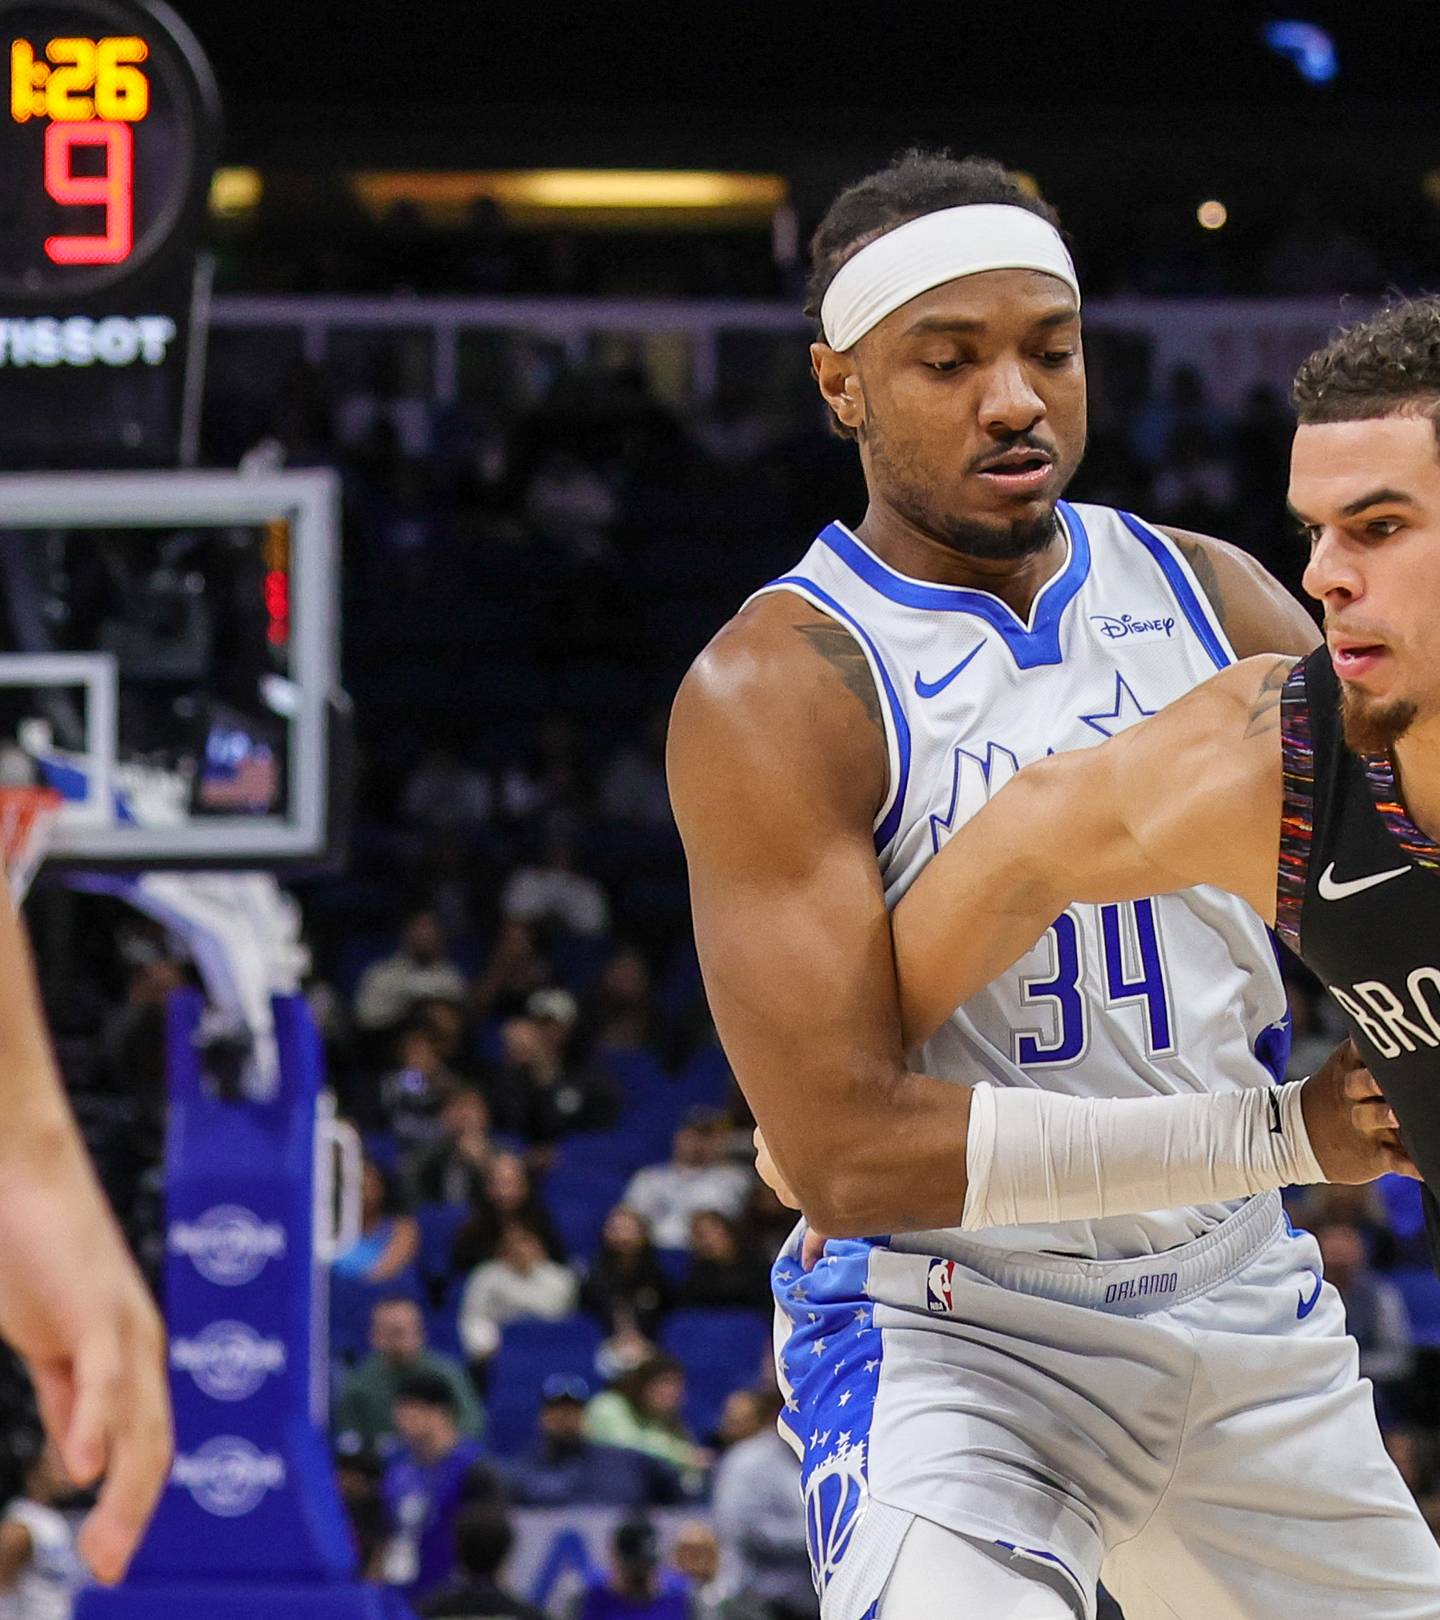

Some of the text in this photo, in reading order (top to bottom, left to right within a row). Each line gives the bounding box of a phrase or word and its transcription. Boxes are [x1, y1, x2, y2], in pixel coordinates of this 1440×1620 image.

[11, 37, 148, 123] 1:26
[44, 120, 134, 265] 9
[1011, 897, 1177, 1063] 34
[1105, 1272, 1178, 1303] ORLANDO
